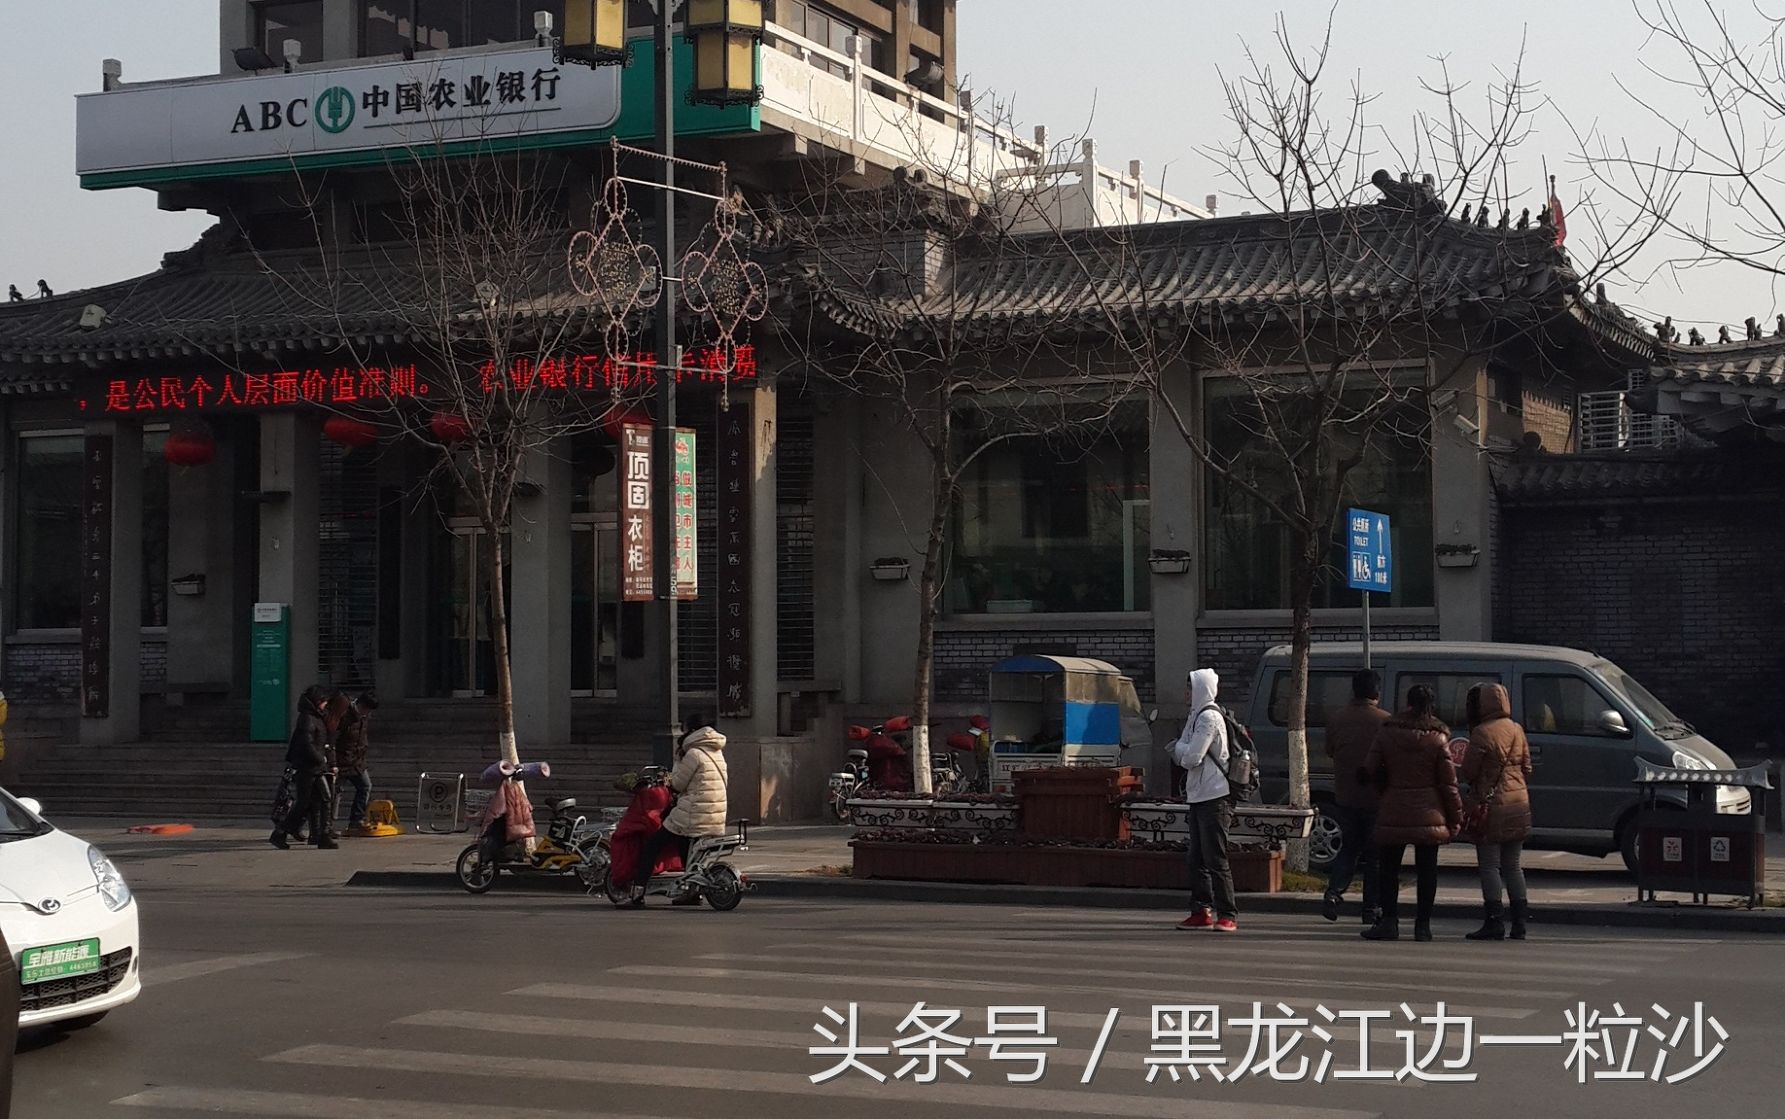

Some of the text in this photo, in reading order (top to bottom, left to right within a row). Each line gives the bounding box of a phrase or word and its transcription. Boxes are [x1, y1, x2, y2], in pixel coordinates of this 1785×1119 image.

[231, 66, 562, 134] ABC 中国农业银行
